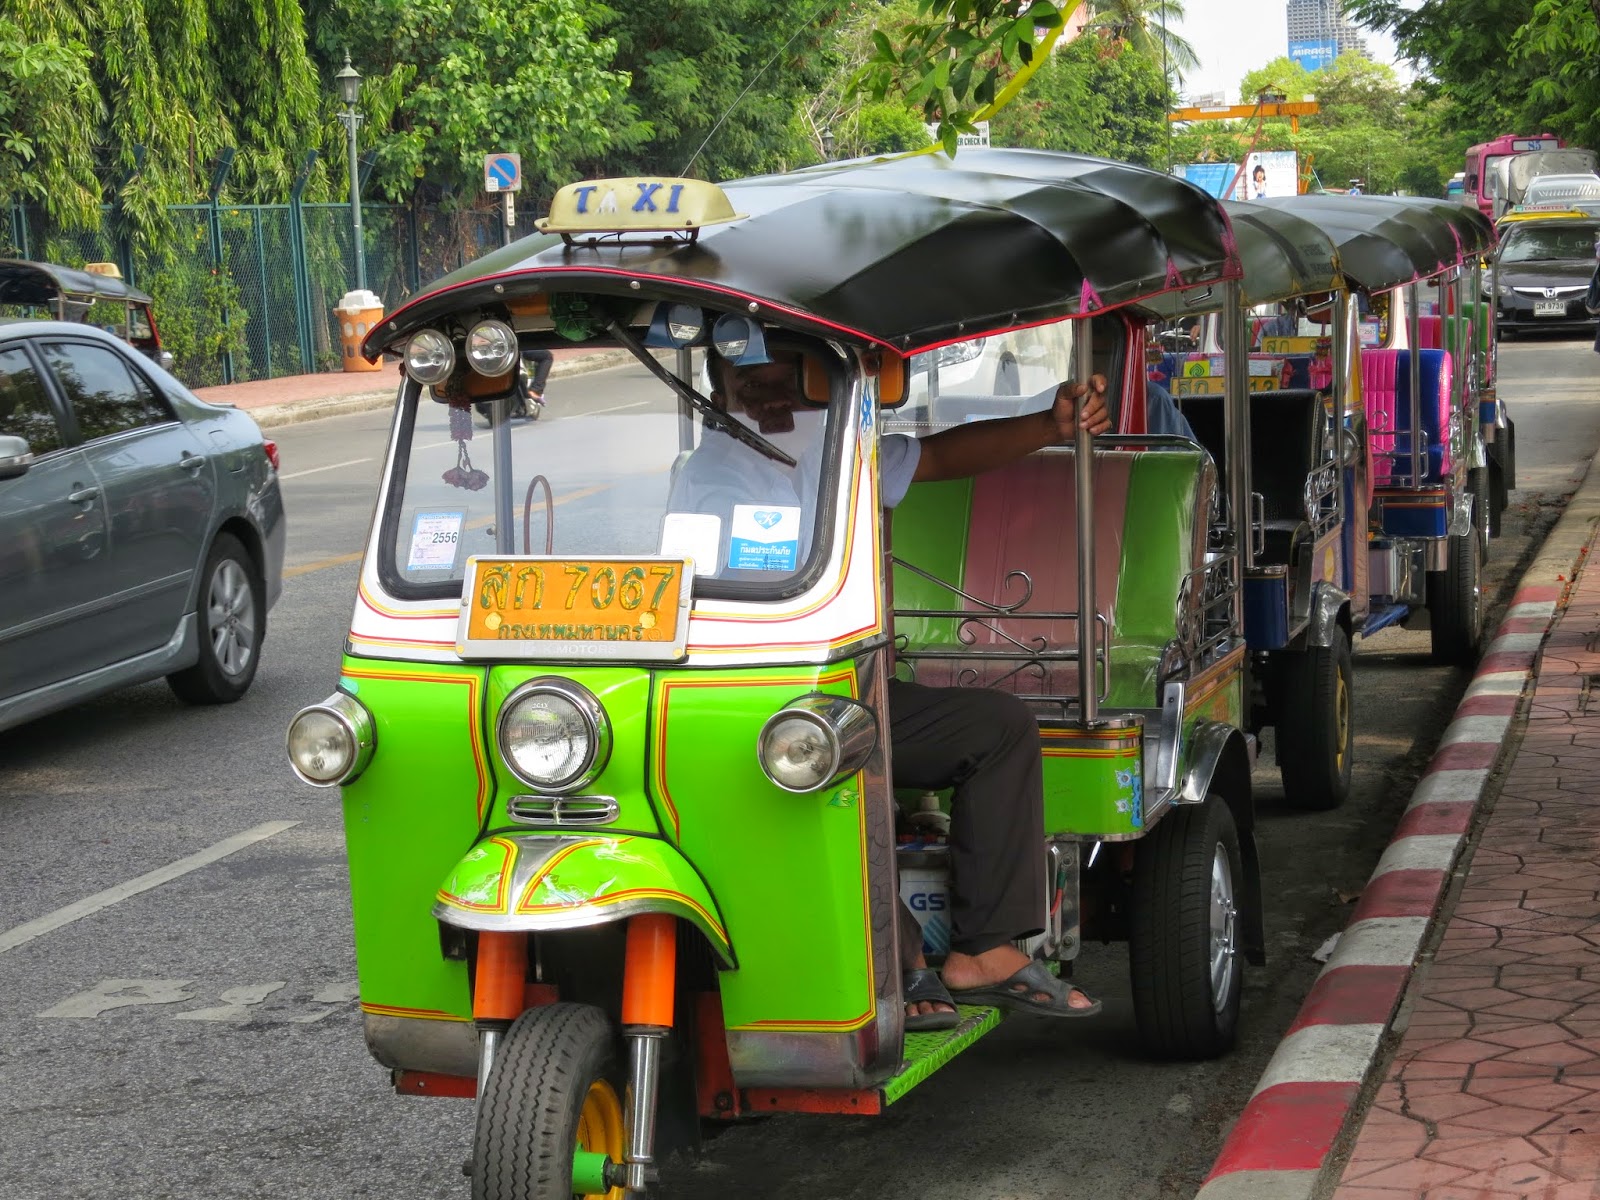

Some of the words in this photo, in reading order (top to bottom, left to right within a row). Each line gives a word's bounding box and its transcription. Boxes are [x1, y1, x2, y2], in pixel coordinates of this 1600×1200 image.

[1292, 47, 1332, 56] MIRAGE
[574, 183, 684, 214] TAXI
[432, 532, 458, 544] 2556
[481, 564, 545, 610] สก
[565, 566, 675, 610] 7067
[909, 893, 946, 911] GS
